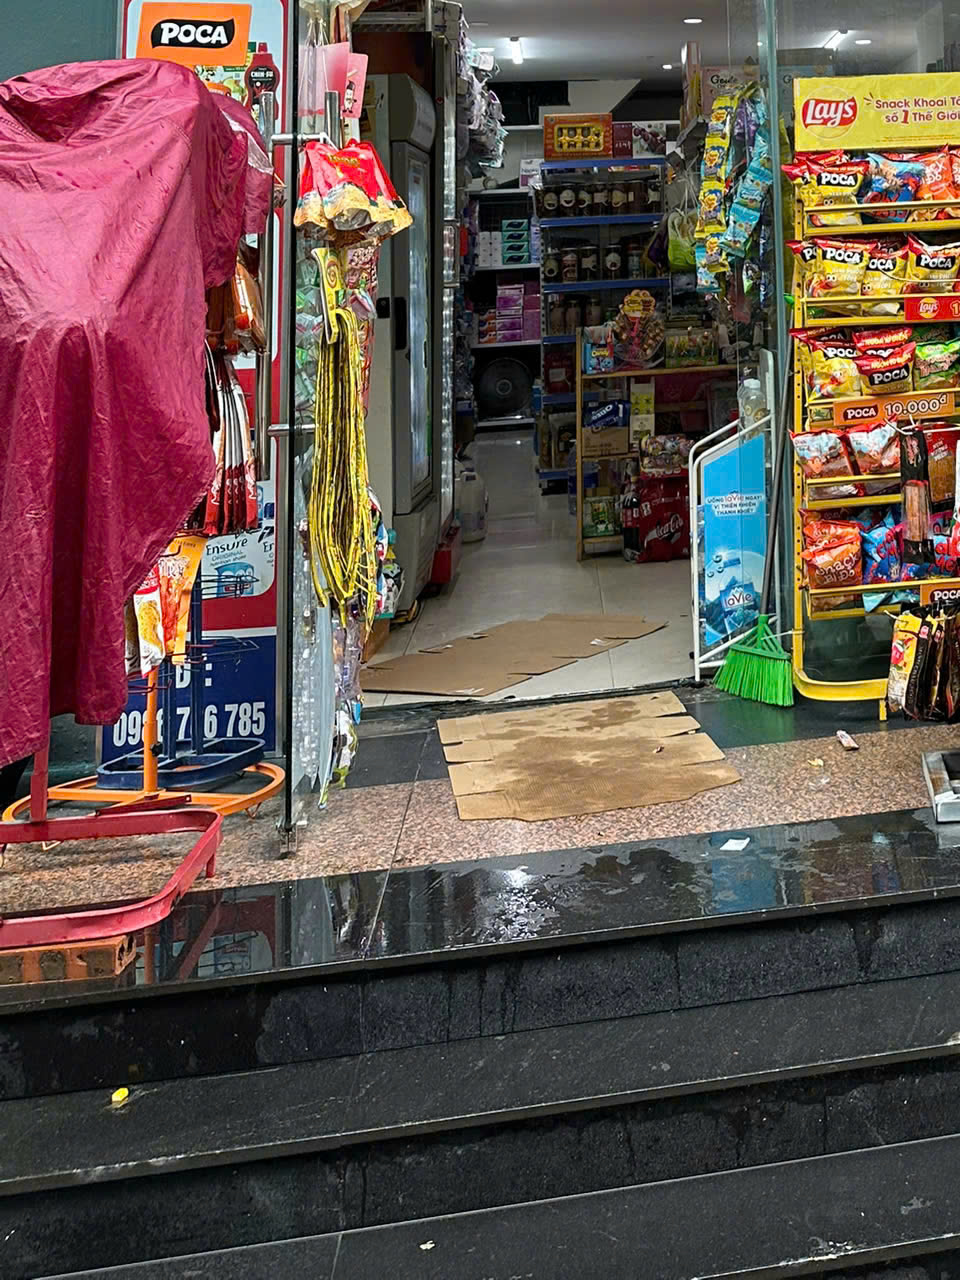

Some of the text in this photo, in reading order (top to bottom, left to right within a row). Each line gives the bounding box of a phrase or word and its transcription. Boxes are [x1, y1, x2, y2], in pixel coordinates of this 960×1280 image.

[160, 21, 229, 47] POCA
[875, 99, 911, 110] Snack
[914, 96, 948, 107] Khoai
[885, 111, 899, 123] số
[902, 110, 909, 124] 1
[912, 109, 933, 121] Thế
[820, 173, 856, 186] POCA
[825, 248, 861, 264] POCA
[920, 256, 952, 269] POCA
[868, 259, 895, 270] OCA
[873, 368, 908, 384] POCA
[846, 409, 876, 420] POCA
[206, 538, 248, 556] Ensure
[225, 701, 265, 737] 785
